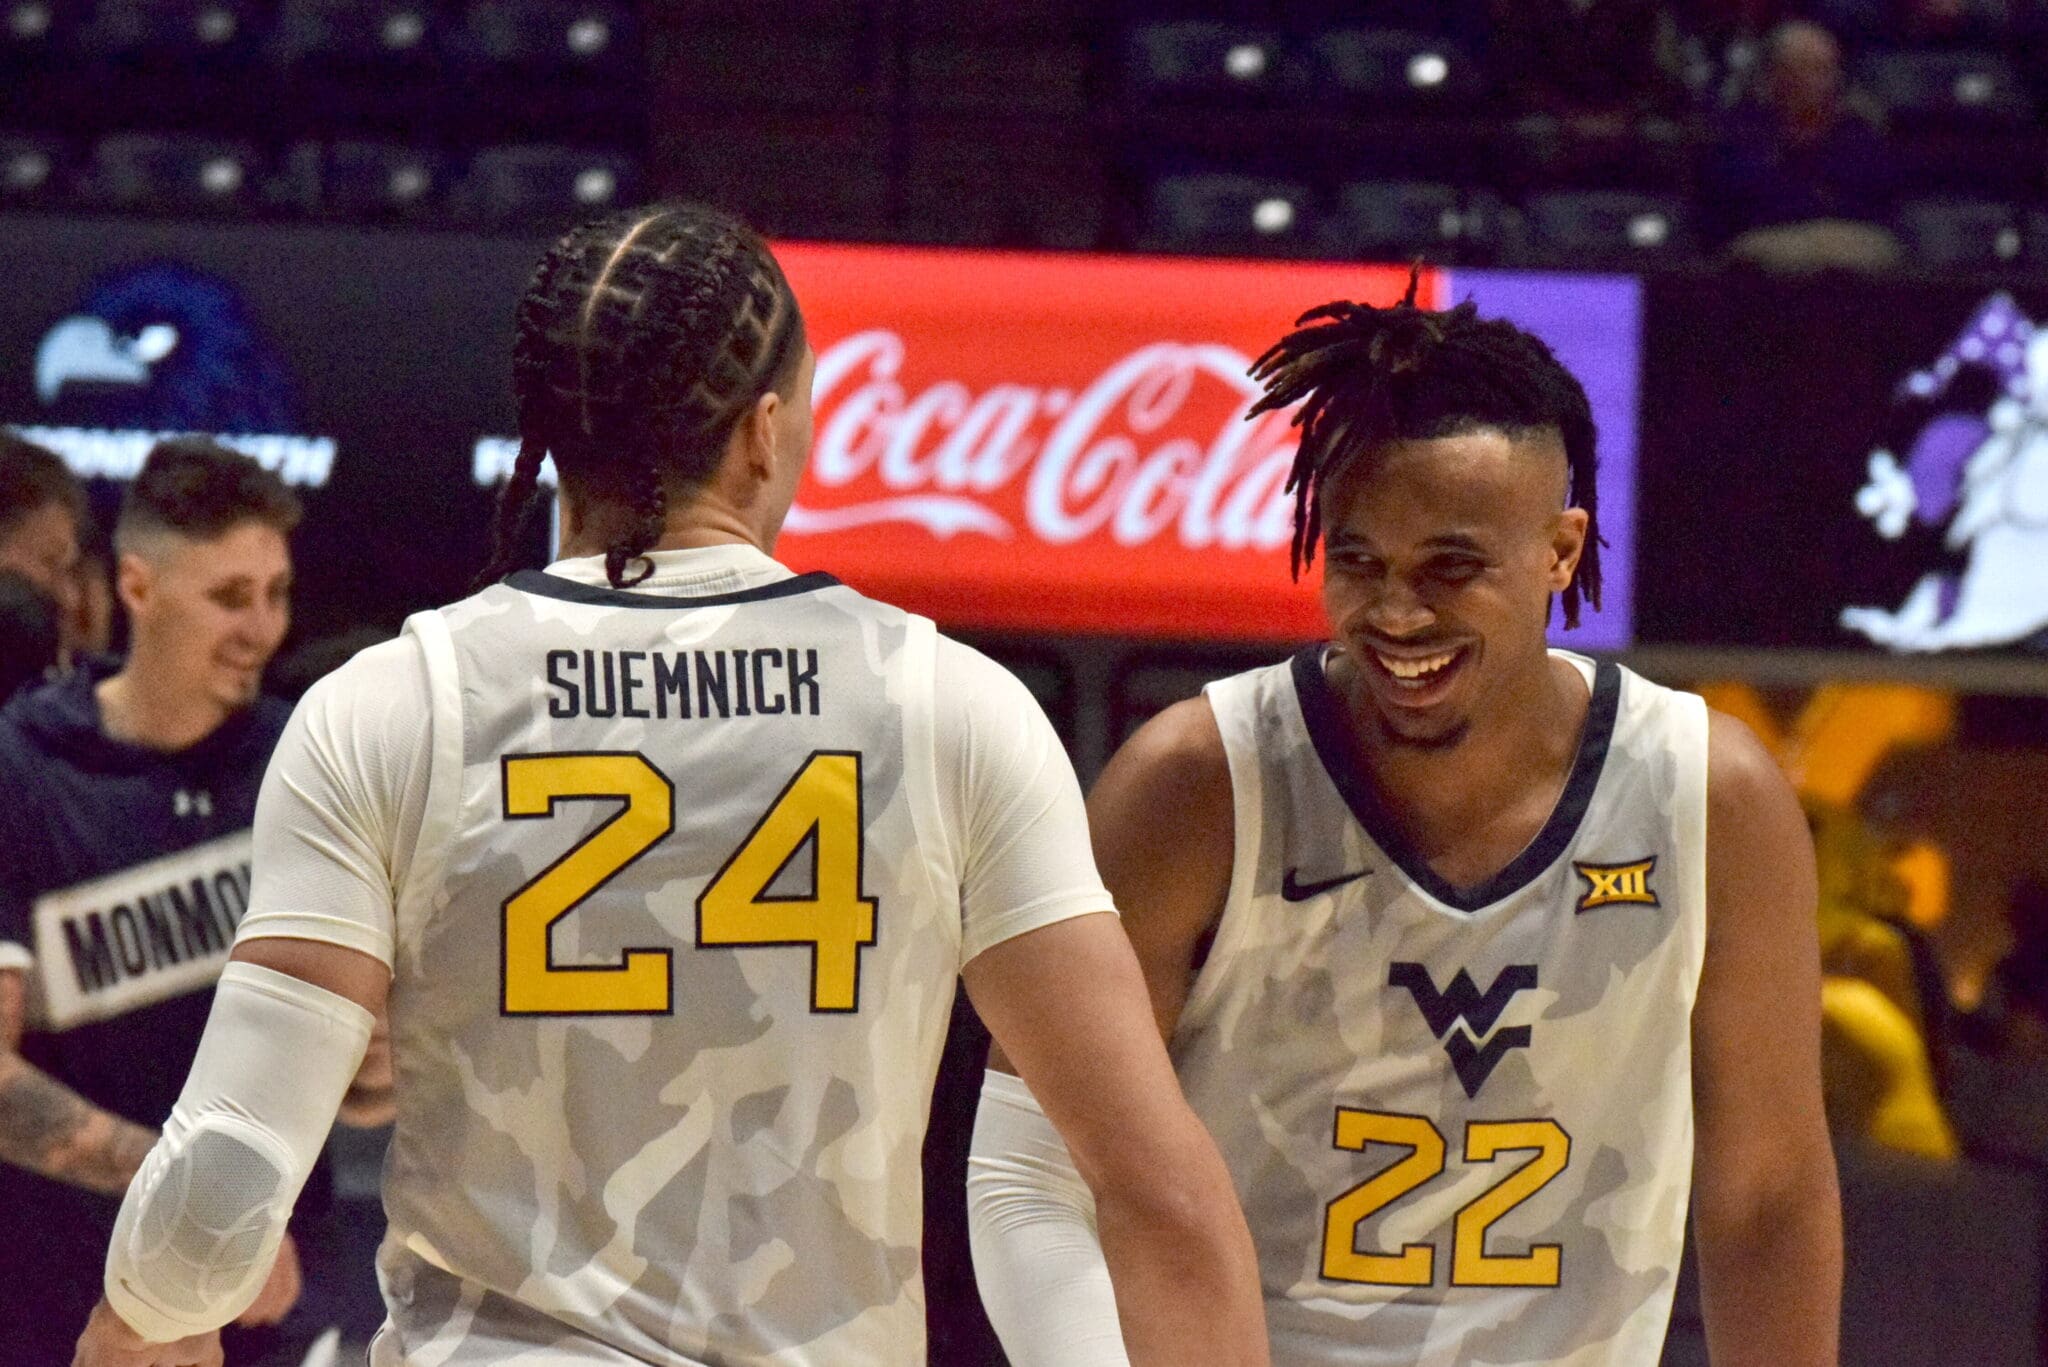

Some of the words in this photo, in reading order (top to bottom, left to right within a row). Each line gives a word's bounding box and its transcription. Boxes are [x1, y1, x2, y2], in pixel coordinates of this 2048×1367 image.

[546, 647, 821, 720] SUEMNICK
[500, 749, 880, 1017] 24
[1319, 1106, 1572, 1288] 22
